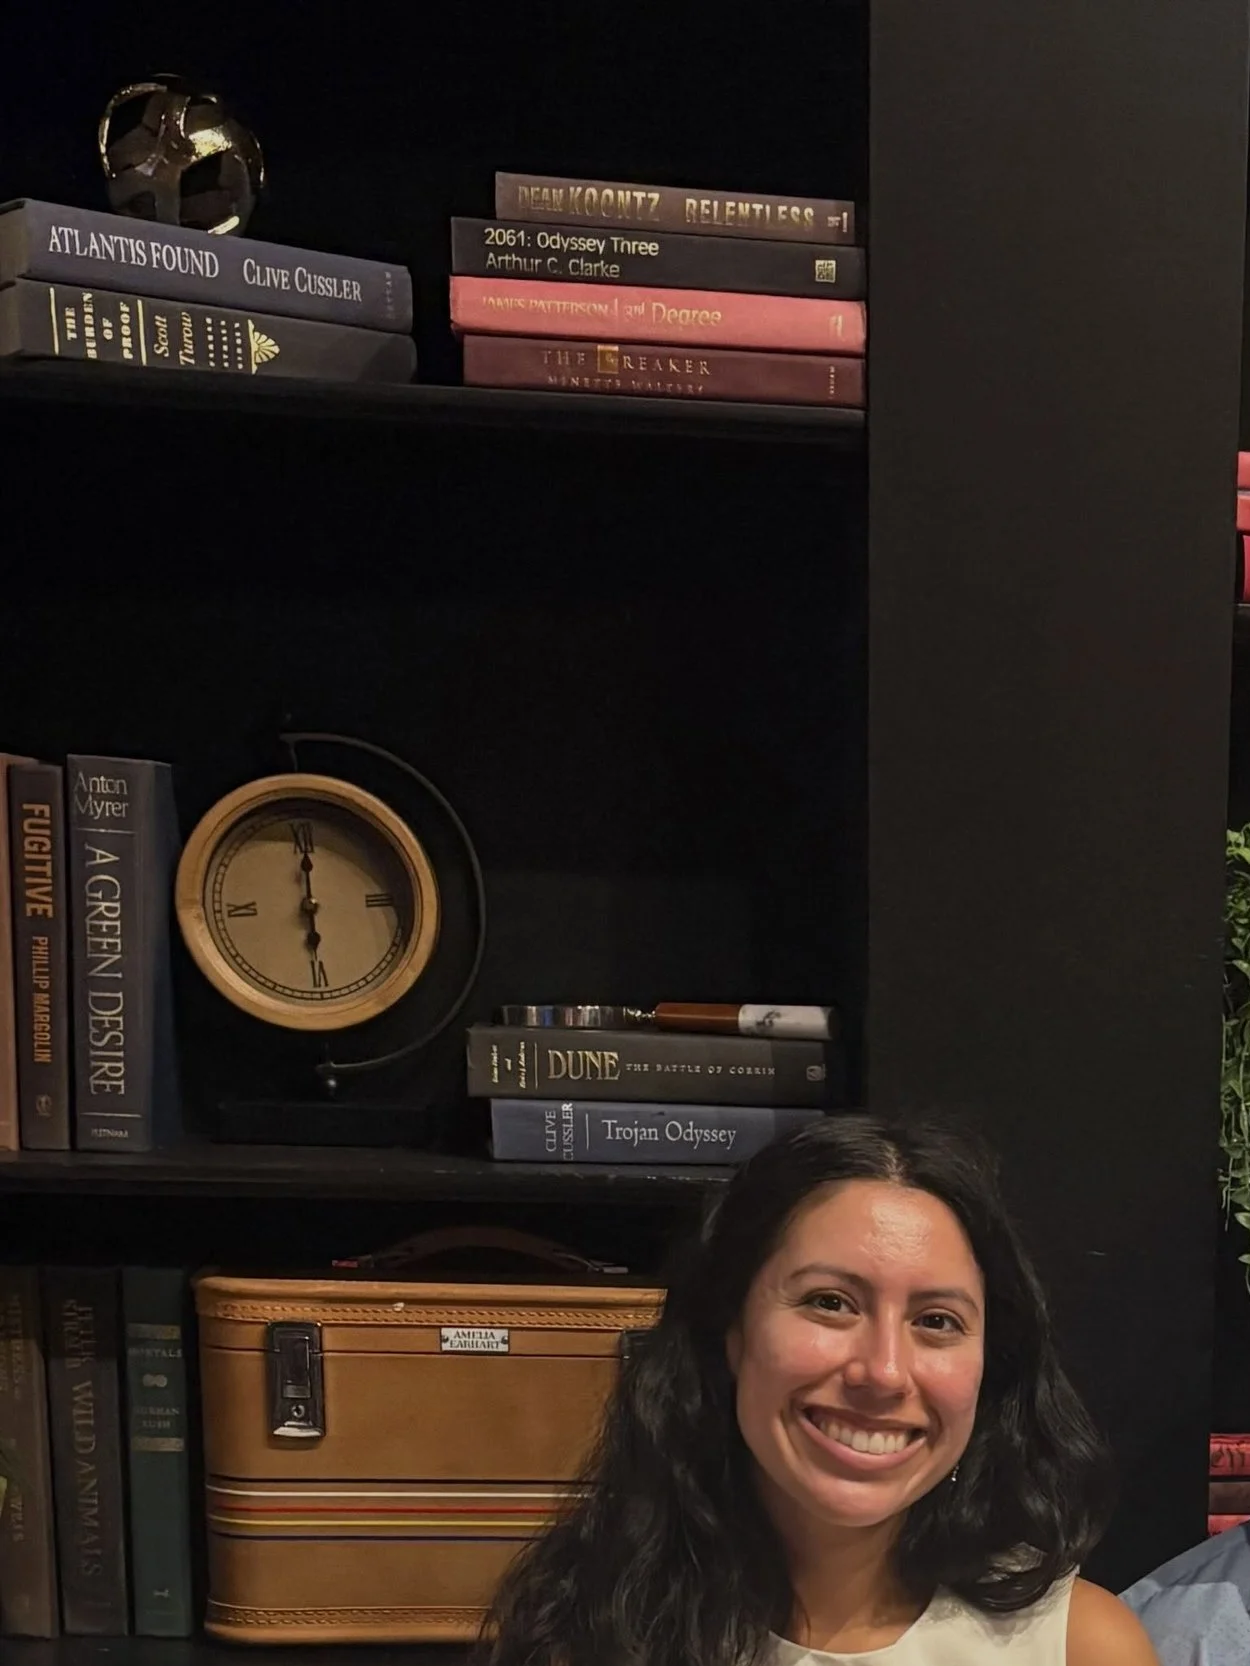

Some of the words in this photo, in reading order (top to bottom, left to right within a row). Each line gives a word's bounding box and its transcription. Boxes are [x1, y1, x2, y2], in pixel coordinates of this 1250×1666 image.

[568, 184, 660, 222] KOONTZ
[684, 197, 816, 231] RELENTLESS
[48, 223, 148, 267] ATLANTIS
[150, 242, 220, 279] FOUND
[242, 257, 292, 291] CLIVE
[294, 266, 363, 303] CUSSLER
[483, 227, 531, 248] 2061:
[537, 230, 606, 256] Odyssey
[610, 236, 660, 257] Three
[485, 252, 543, 274] Arthur
[547, 257, 563, 276] C.
[568, 258, 621, 279] Clarke
[65, 306, 77, 341] THE
[83, 291, 98, 359] BURDEN
[102, 317, 114, 341] OF
[120, 301, 135, 360] PROOF
[153, 314, 170, 358] Scott
[651, 302, 722, 327] Degree
[178, 311, 196, 367] Turow
[75, 771, 129, 796] Anton
[76, 794, 129, 820] Myrer
[20, 802, 54, 919] FUGITIVE
[84, 843, 122, 868] A
[84, 874, 123, 980] GREEN
[31, 935, 50, 990] PHILLIP
[32, 992, 53, 1065] MARGOLIN
[88, 990, 126, 1097] DESIRE
[547, 1049, 621, 1082] DUNE
[625, 1063, 650, 1073] THE
[655, 1063, 702, 1075] BATTLE
[707, 1065, 724, 1075] OF
[728, 1065, 777, 1077] CORRIN
[544, 1108, 556, 1152] CLIVE
[562, 1102, 574, 1161] CUSSLER
[602, 1119, 660, 1147] Trojan
[664, 1120, 738, 1151] Odyssey
[449, 1339, 500, 1349] EARHART
[453, 1330, 496, 1340] AMELIA
